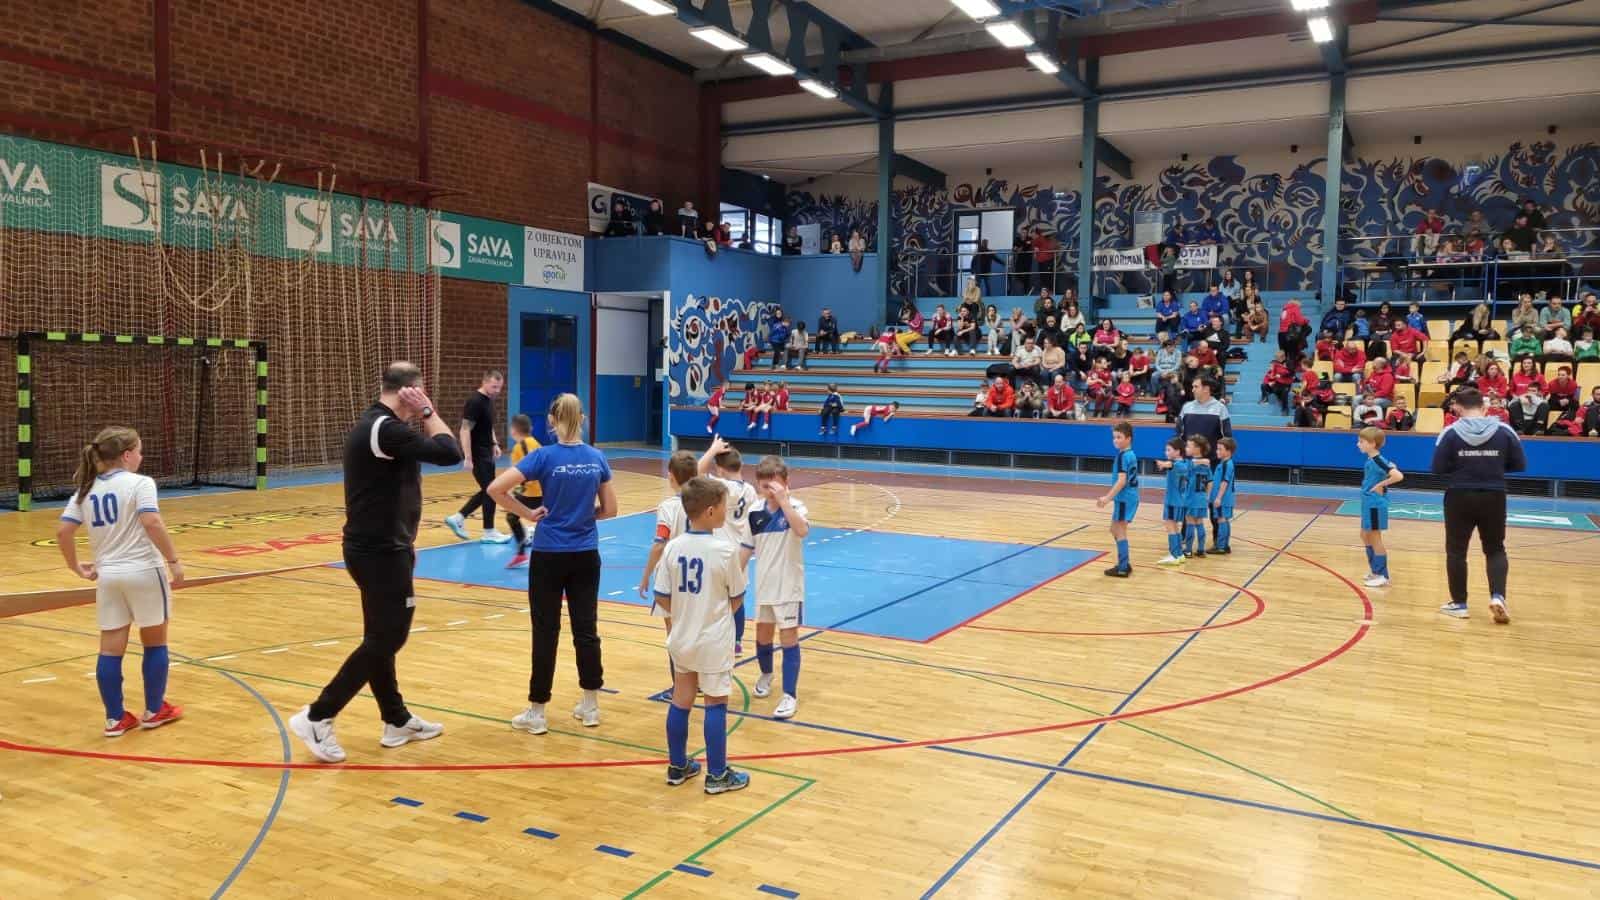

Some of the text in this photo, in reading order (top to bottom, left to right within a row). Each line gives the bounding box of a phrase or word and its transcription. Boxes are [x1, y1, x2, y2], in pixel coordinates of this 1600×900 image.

[173, 186, 250, 220] SAVA
[340, 213, 399, 243] SAVA
[527, 230, 582, 249] Z OBJEKTOM
[467, 233, 513, 259] SAVA
[533, 247, 577, 265] UPRAVLJA
[90, 493, 118, 527] 10
[734, 496, 746, 519] 3
[678, 556, 704, 594] 13
